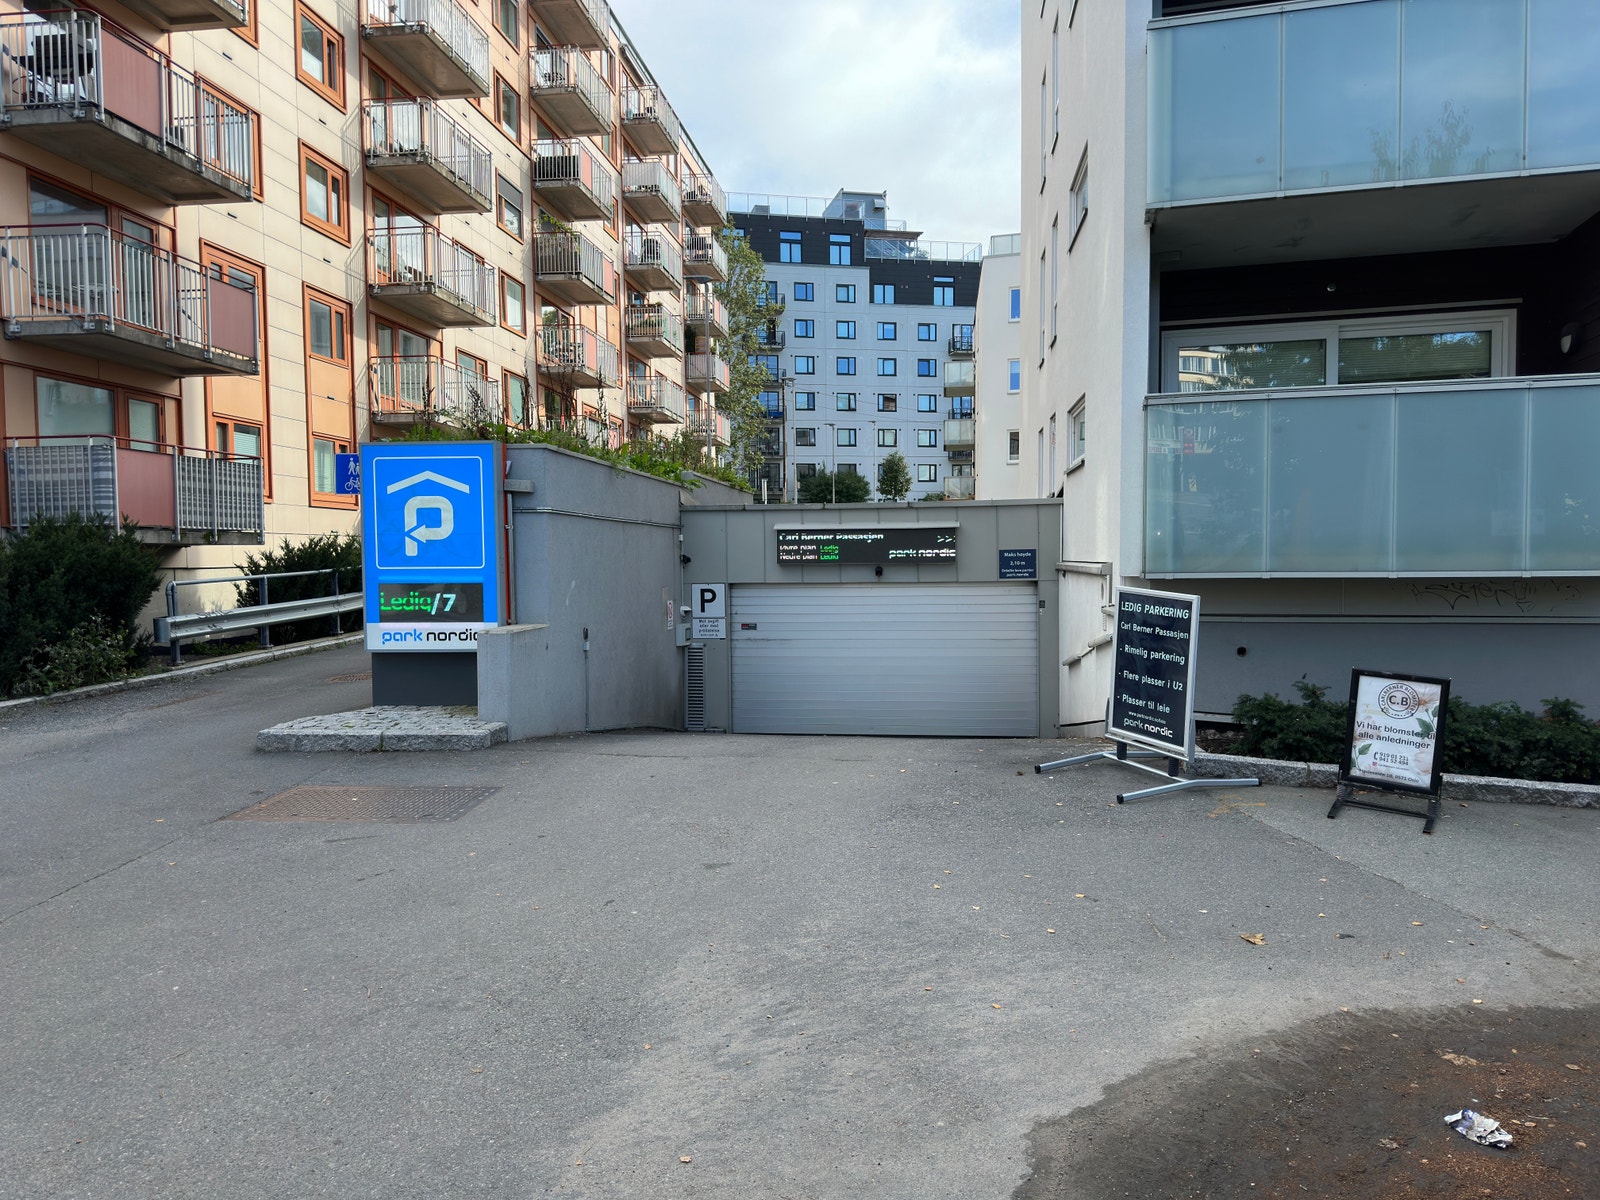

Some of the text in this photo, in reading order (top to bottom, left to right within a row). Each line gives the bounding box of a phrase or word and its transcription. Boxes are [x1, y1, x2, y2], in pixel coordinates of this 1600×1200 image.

[889, 548, 956, 559] park nordic
[700, 588, 716, 613] P
[1121, 601, 1189, 619] LEDIG PARKERING
[382, 629, 422, 645] park
[1120, 621, 1189, 640] Carl Berner Passasjen
[1125, 644, 1185, 665] Rimelig parkering
[1124, 671, 1139, 681] Flere
[1142, 674, 1165, 687] plasser
[1173, 680, 1183, 691] U2
[1122, 694, 1146, 707] Plasser
[1157, 703, 1170, 713] leie
[1389, 695, 1408, 706] C.B
[1124, 718, 1173, 738] park nordic
[1367, 722, 1382, 730] har
[1376, 735, 1430, 749] anledninger
